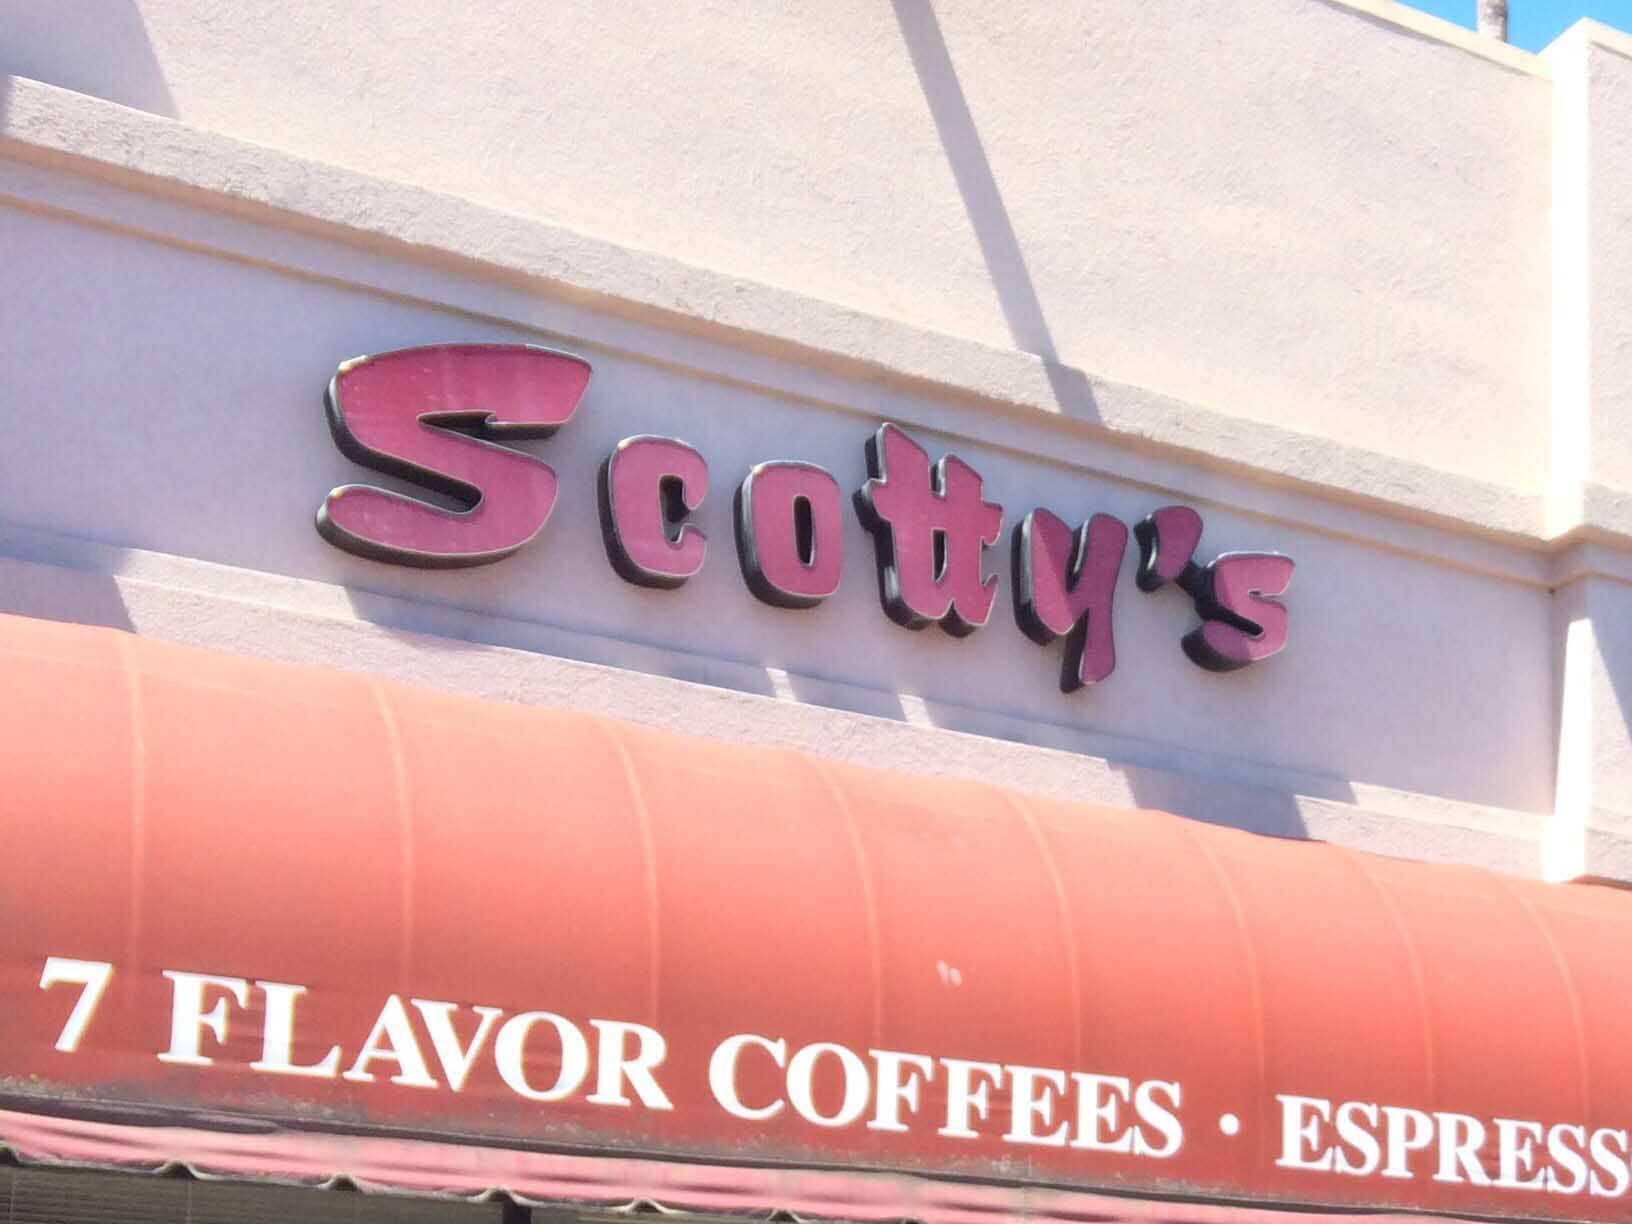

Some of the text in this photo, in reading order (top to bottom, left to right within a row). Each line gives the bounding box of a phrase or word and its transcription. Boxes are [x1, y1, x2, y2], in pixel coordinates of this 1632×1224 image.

[314, 342, 1295, 693] Scotty's
[39, 956, 112, 1052] 7
[157, 969, 673, 1110] FLAVOR
[708, 1034, 1182, 1158] COFFEES
